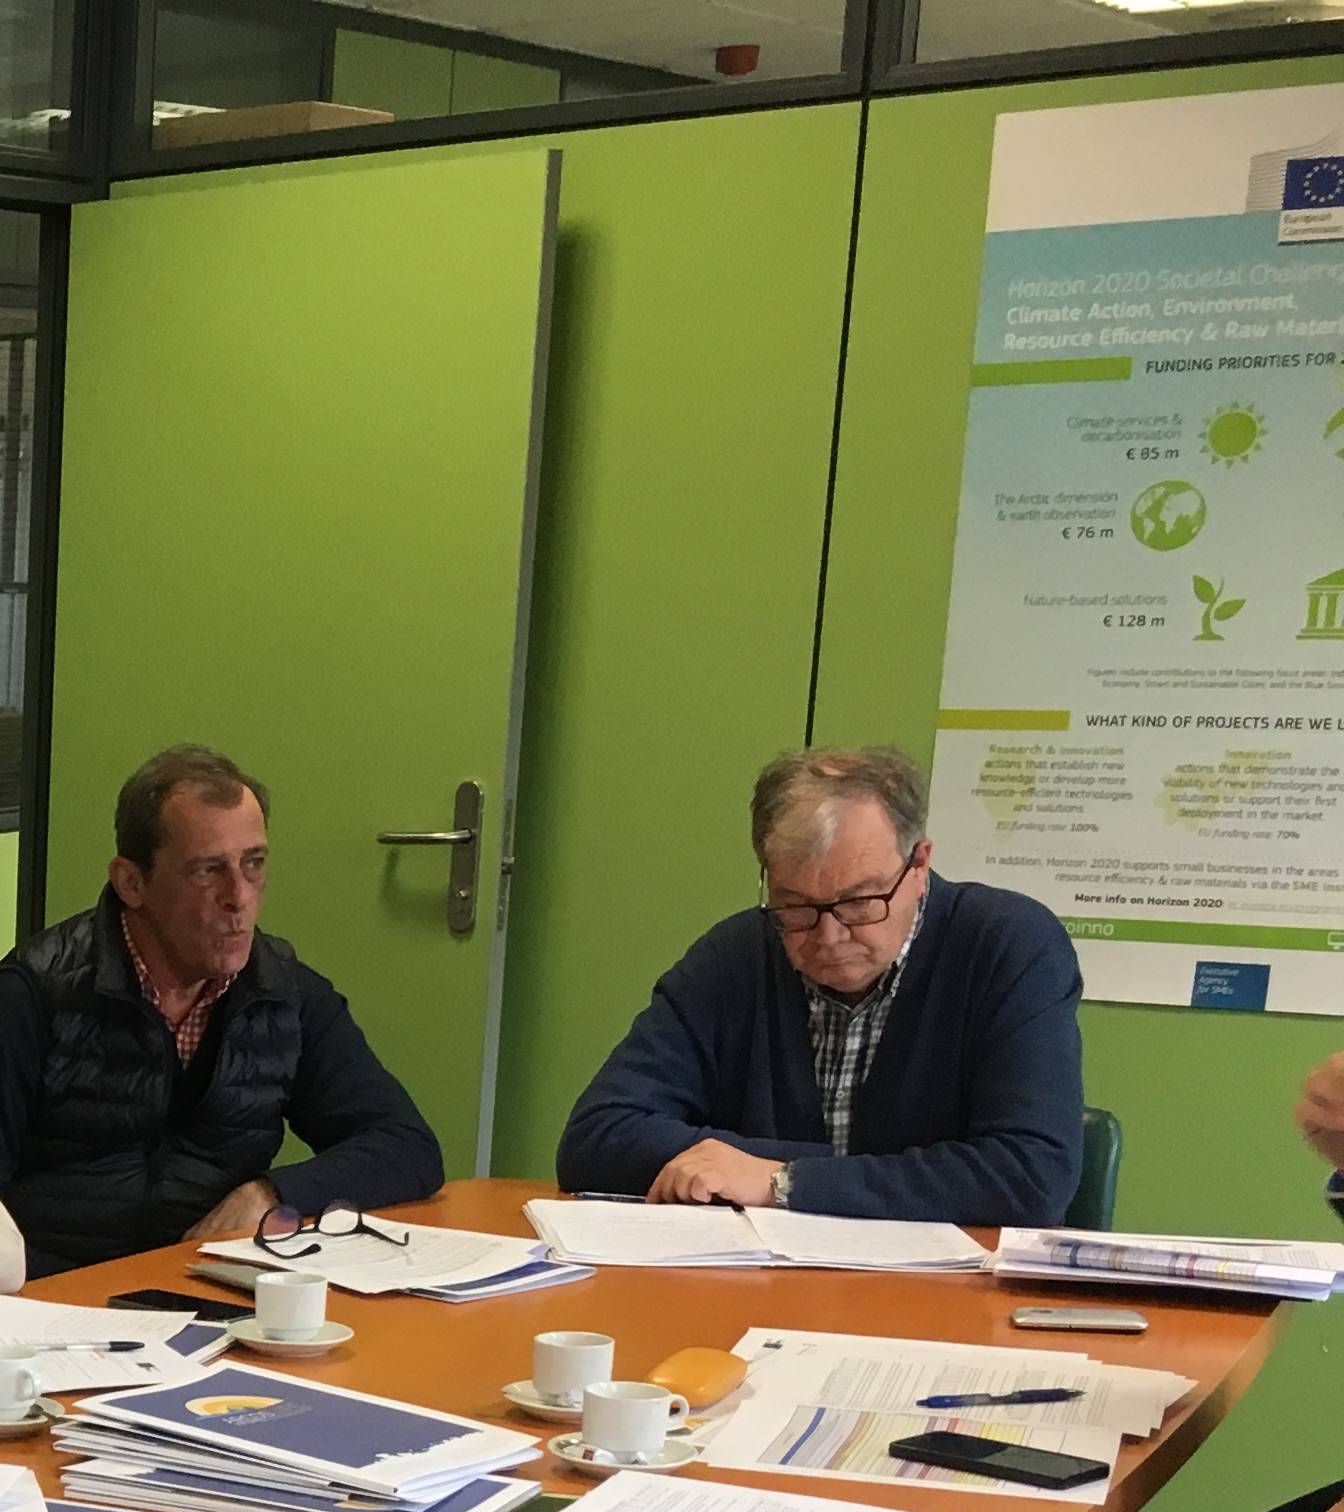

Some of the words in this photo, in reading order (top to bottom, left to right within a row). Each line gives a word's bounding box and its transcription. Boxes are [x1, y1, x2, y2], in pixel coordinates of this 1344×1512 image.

[1008, 278, 1087, 299] Horizon
[1092, 271, 1152, 295] 2020
[1155, 264, 1242, 290] Societal
[1007, 304, 1083, 325] Climate
[1087, 300, 1155, 320] Action,
[1163, 293, 1298, 316] Environment,
[1003, 331, 1093, 350] Resource
[1099, 325, 1195, 347] Efficiency
[1200, 321, 1216, 341] &
[1225, 320, 1270, 339] Raw
[1145, 357, 1213, 373] FUNDING
[1218, 353, 1300, 370] PRIORITIES
[1305, 352, 1337, 366] FOR
[1066, 416, 1114, 429] Climate
[1118, 415, 1168, 428] services
[1171, 413, 1183, 426] &
[1126, 448, 1135, 460] €
[1140, 447, 1160, 460] 85
[1165, 449, 1179, 459] m
[994, 493, 1016, 505] The
[1018, 493, 1050, 505] Arctic
[1054, 492, 1118, 504] dimension
[1010, 509, 1040, 521] earth
[1044, 508, 1116, 521] observation
[1062, 527, 1070, 539] €
[1077, 527, 1095, 538] 76
[1100, 528, 1114, 538] m
[1023, 593, 1108, 606] Nature-based
[1110, 593, 1168, 606] solutions
[1103, 615, 1113, 627] €
[1118, 615, 1146, 627] 128
[1151, 617, 1165, 626] m
[1086, 715, 1127, 727] WHAT
[1132, 715, 1167, 728] KIND
[1172, 716, 1192, 728] OF
[1196, 716, 1269, 729] PROJECTS
[1274, 717, 1303, 730] ARE
[1308, 717, 1332, 730] WE
[989, 744, 1042, 755] Research
[984, 759, 1022, 769] actions
[1026, 759, 1048, 770] that
[1050, 759, 1099, 770] establish
[1102, 762, 1125, 771] new
[1175, 764, 1215, 774] actions
[1218, 763, 1240, 774] that
[1243, 764, 1318, 776] demonstrate
[1321, 766, 1340, 777] the
[980, 773, 1036, 785] knowledge
[1039, 776, 1050, 784] or
[1052, 774, 1095, 786] develop
[1098, 776, 1127, 785] more
[1163, 777, 1205, 789] viability
[1209, 778, 1222, 788] of
[1225, 780, 1249, 790] new
[1251, 779, 1323, 792] technologies
[970, 786, 1061, 798] resource-efficient
[1064, 788, 1134, 801] technologies
[1169, 792, 1220, 803] solutions
[1223, 795, 1235, 804] or
[1238, 795, 1281, 806] support
[1284, 795, 1311, 806] their
[1315, 795, 1337, 806] first
[1013, 803, 1032, 812] and
[1036, 803, 1084, 813] solutions
[1177, 807, 1243, 819] deployment
[1247, 809, 1257, 819] in
[1261, 809, 1279, 820] the
[1070, 823, 1100, 832] 100%
[1212, 828, 1249, 839] funding
[1277, 830, 1301, 839] 70%
[985, 855, 996, 864] In
[1046, 857, 1087, 868] Horizon
[1090, 858, 1121, 869] 2020
[1123, 860, 1170, 871] supports
[1173, 862, 1204, 872] small
[1207, 862, 1268, 875] businesses
[1272, 865, 1282, 875] in
[1286, 865, 1304, 876] the
[1308, 867, 1339, 877] areas
[1055, 873, 1101, 882] resource
[1104, 873, 1154, 886] efficiency
[1158, 876, 1168, 886] &
[1170, 878, 1191, 886] raw
[1194, 877, 1247, 888] materials
[1251, 880, 1268, 889] via
[1271, 880, 1290, 890] the
[1292, 881, 1319, 892] SME
[1074, 893, 1102, 903] More
[1105, 893, 1127, 904] info
[1131, 897, 1144, 905] on
[1147, 896, 1190, 907] Horizon
